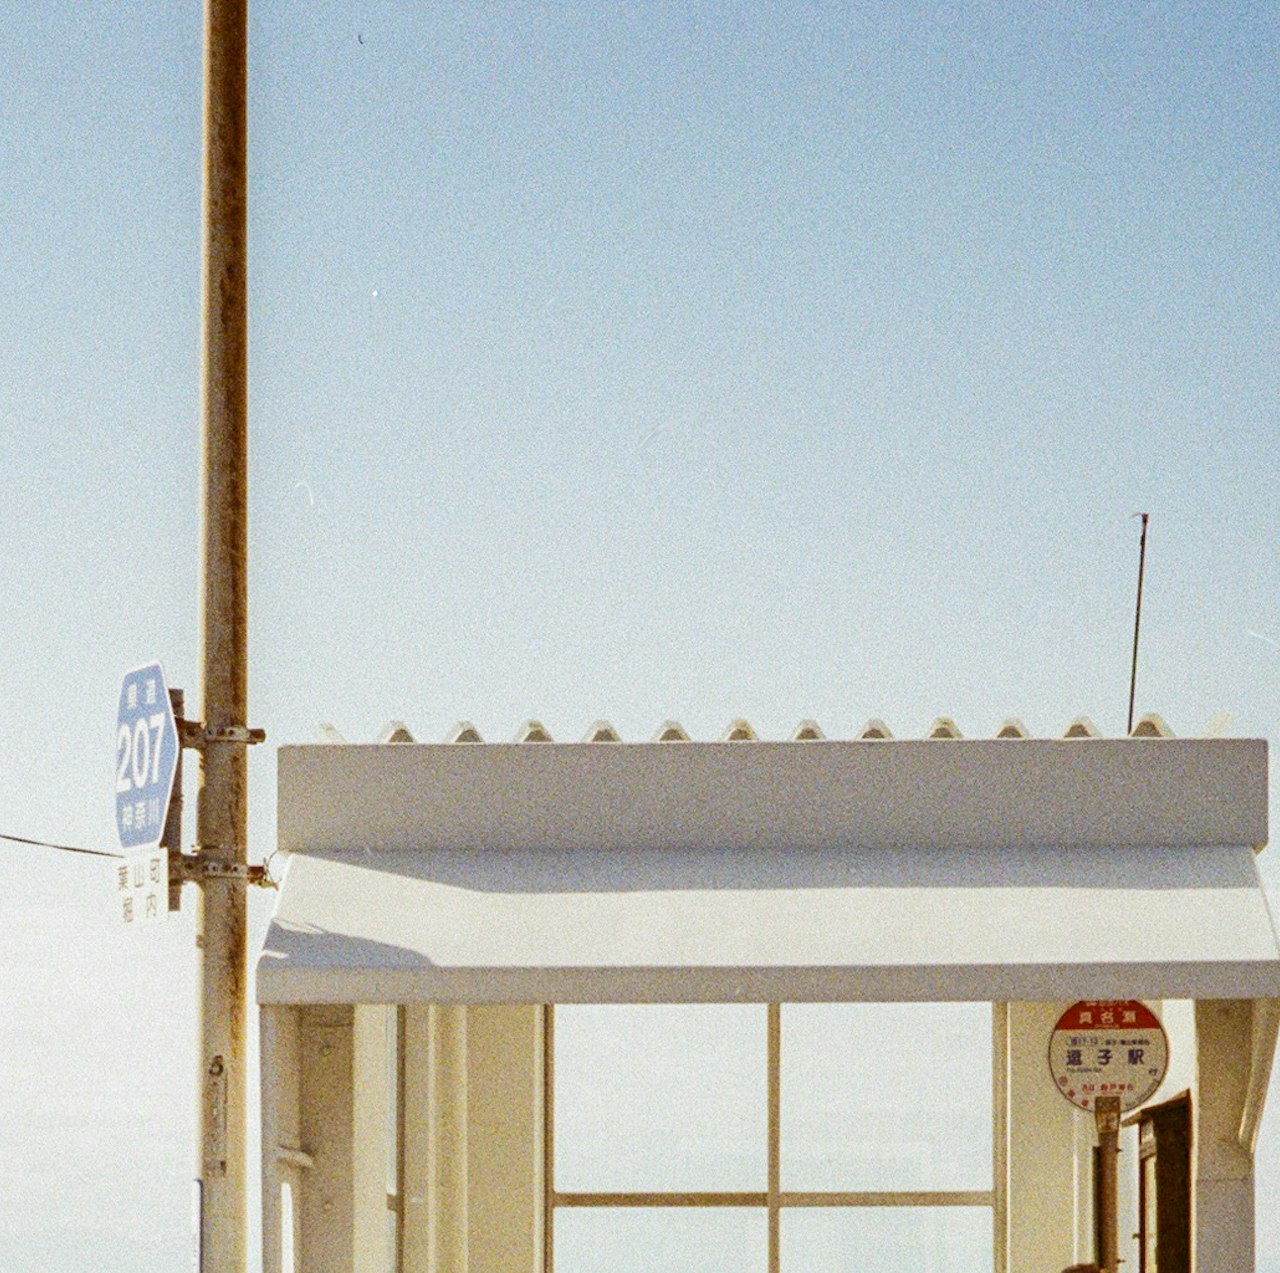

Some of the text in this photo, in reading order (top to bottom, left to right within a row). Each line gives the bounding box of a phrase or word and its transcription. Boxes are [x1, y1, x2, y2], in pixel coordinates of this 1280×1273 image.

[117, 713, 166, 793] 207
[1066, 1048, 1145, 1066] 逗子駅
